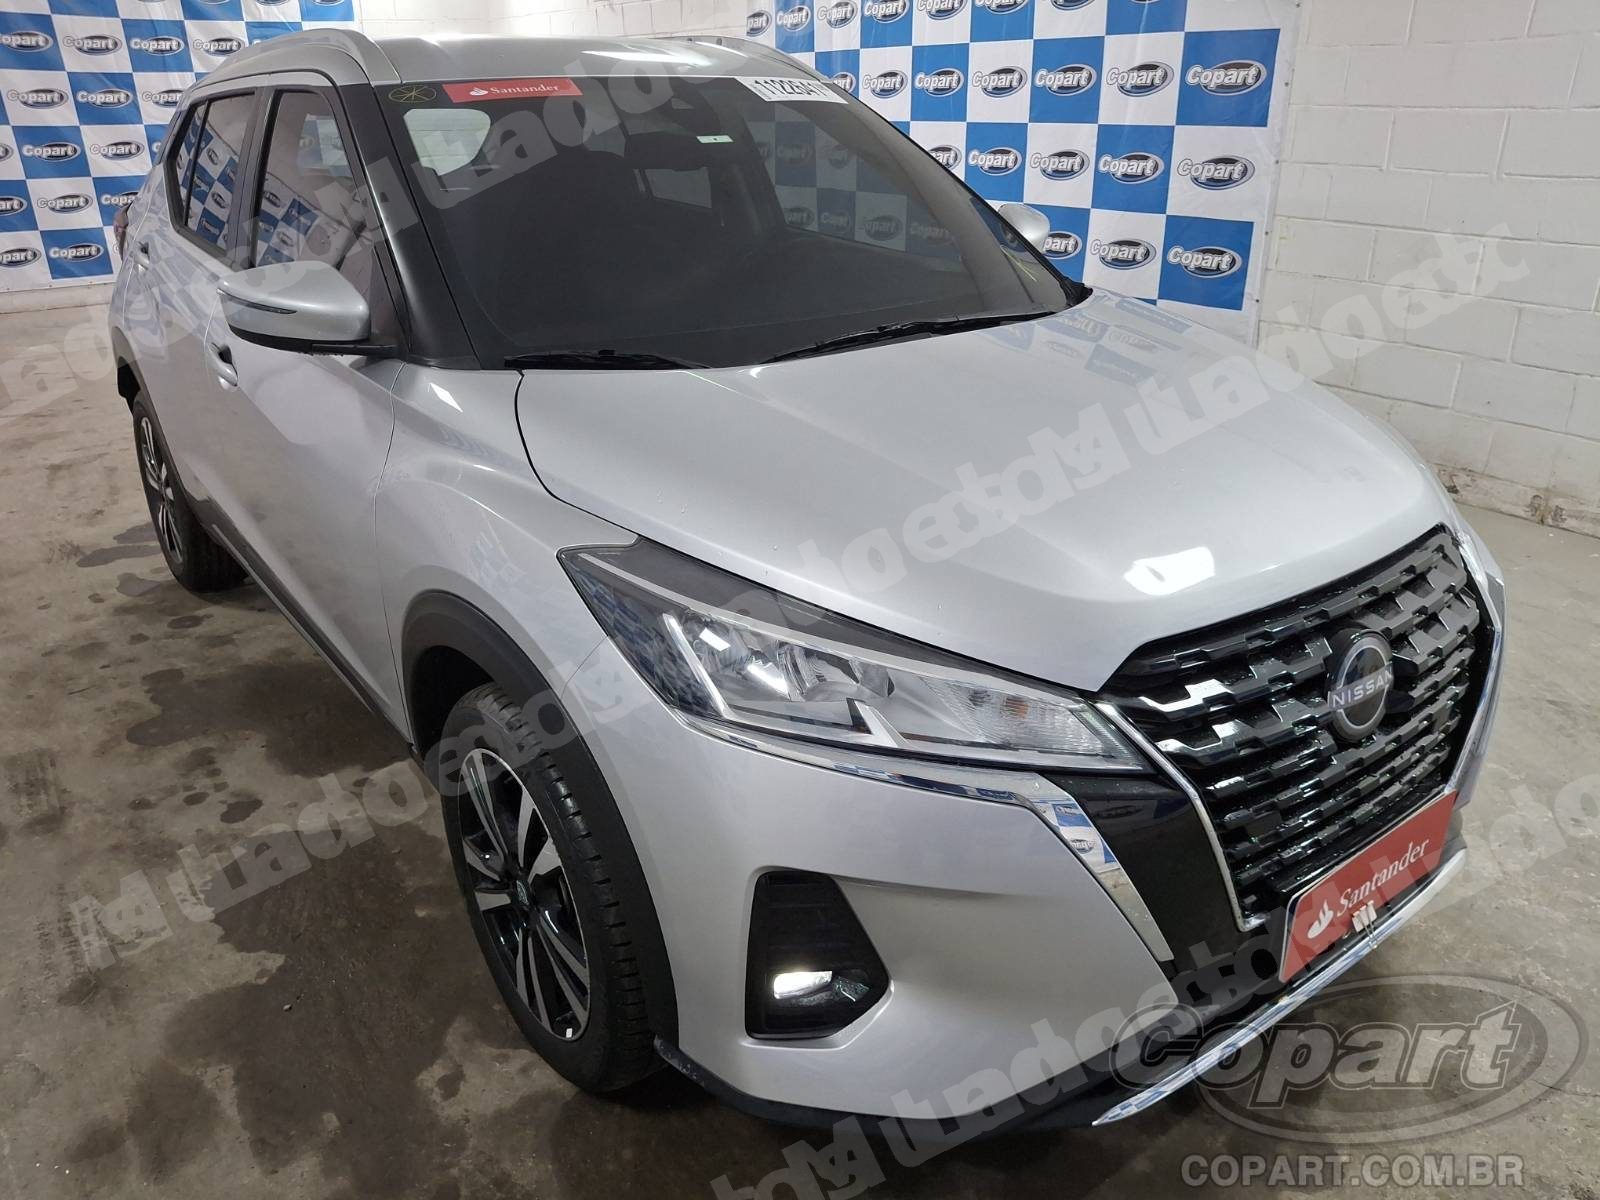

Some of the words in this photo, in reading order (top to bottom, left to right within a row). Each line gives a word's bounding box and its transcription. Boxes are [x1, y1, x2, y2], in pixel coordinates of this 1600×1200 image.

[776, 8, 809, 28] Copart
[817, 3, 853, 21] Copart
[864, 0, 903, 18] Copart
[747, 16, 771, 30] part
[0, 34, 45, 48] opart
[62, 35, 115, 50] Copart
[131, 38, 180, 52] Copart
[193, 39, 239, 52] Copart
[862, 72, 902, 93] Copart
[914, 70, 959, 91] Copart
[972, 69, 1021, 91] Copart
[1035, 68, 1092, 91] Copart
[1106, 67, 1165, 90] Copart
[1185, 64, 1260, 89] Copart
[7, 89, 60, 104] Copart
[77, 90, 128, 105] Copart
[142, 91, 181, 105] Copar
[490, 84, 559, 94] Santander
[22, 144, 76, 159] Copart
[91, 143, 138, 157] Copart
[968, 149, 1018, 169] Copart
[1030, 152, 1081, 174] Copart
[1098, 154, 1155, 177] Copart
[1177, 158, 1244, 182] Copart
[37, 197, 87, 211] Copart
[102, 194, 135, 208] Copa
[50, 246, 99, 260] Copart
[1042, 235, 1078, 253] part
[1090, 239, 1149, 261] Copart
[1167, 245, 1232, 271] Copart
[1331, 665, 1392, 709] NISSAN
[1336, 839, 1430, 917] Santander
